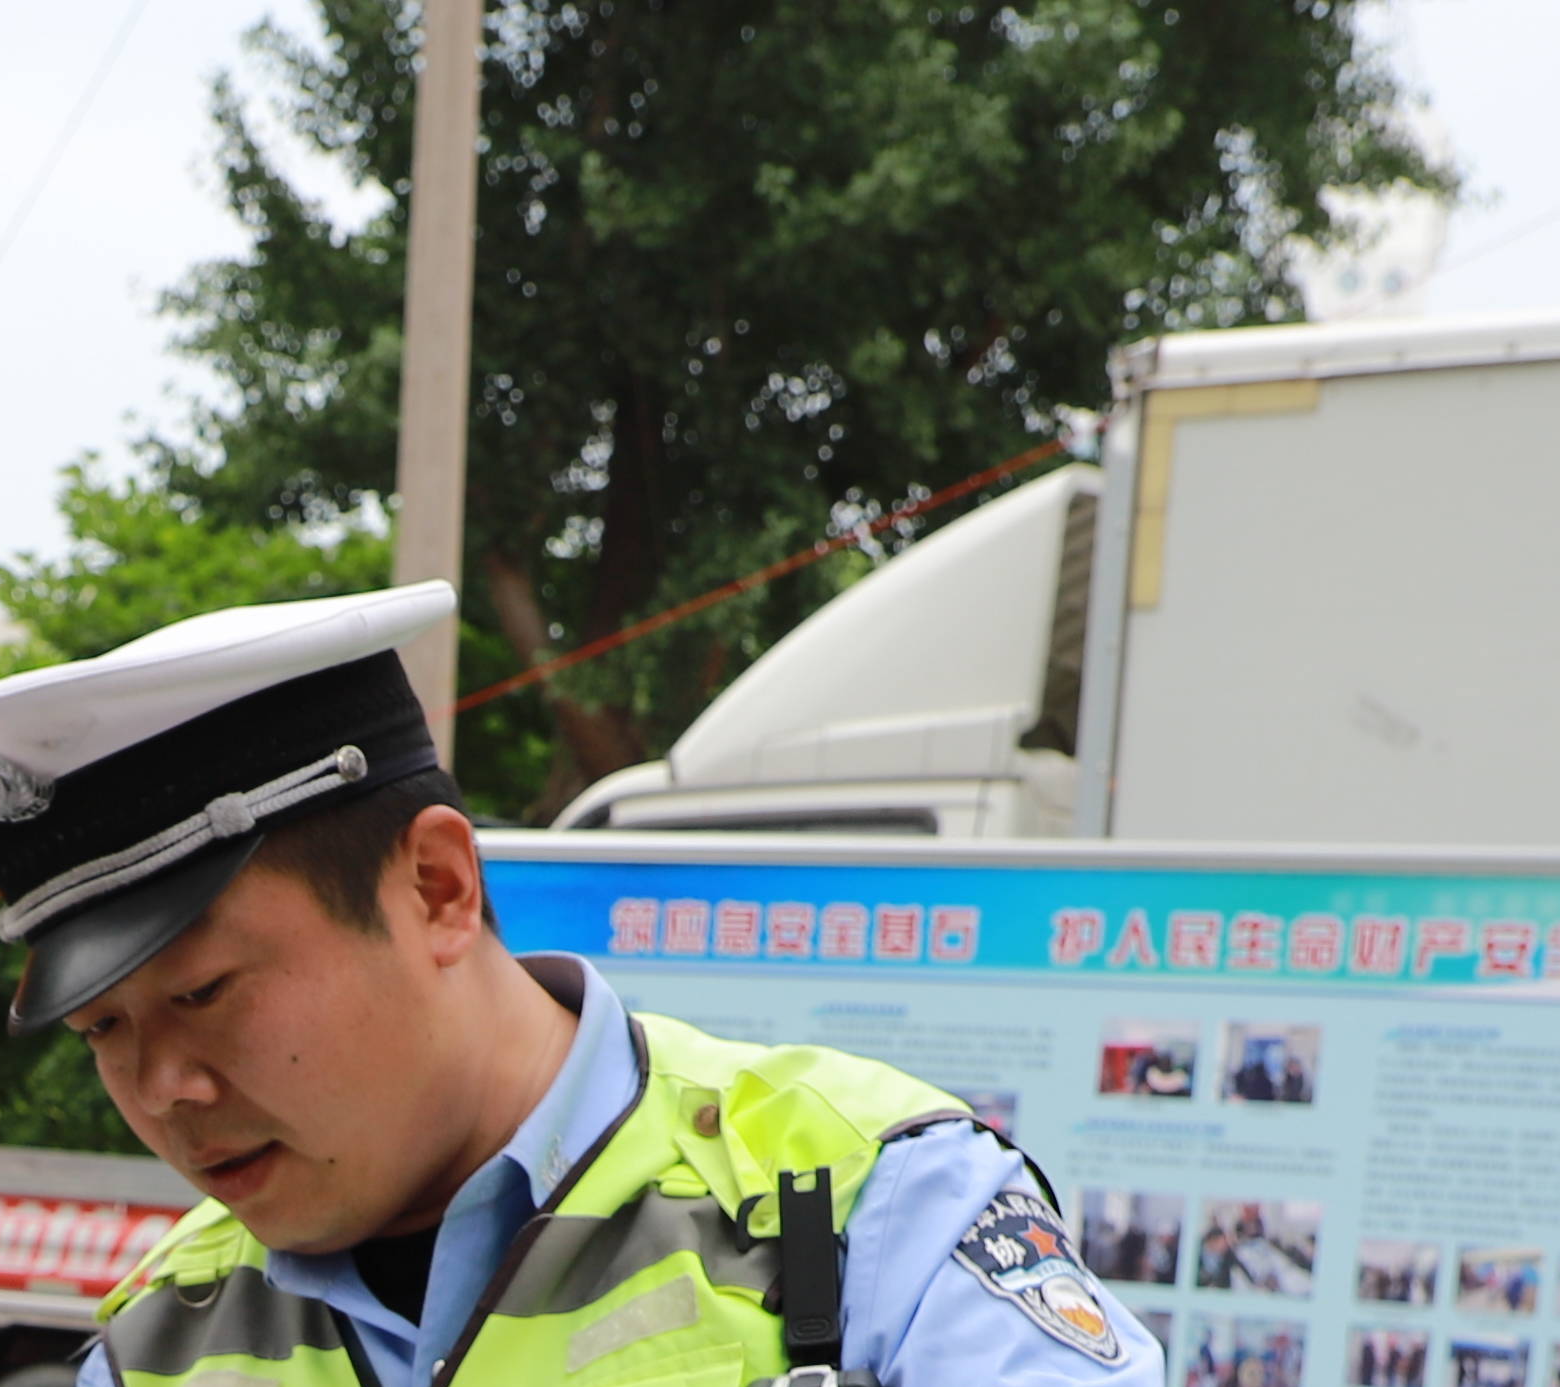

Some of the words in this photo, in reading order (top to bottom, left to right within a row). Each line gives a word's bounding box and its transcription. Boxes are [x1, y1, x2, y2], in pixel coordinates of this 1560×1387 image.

[608, 896, 980, 964] 筑应急安全基石
